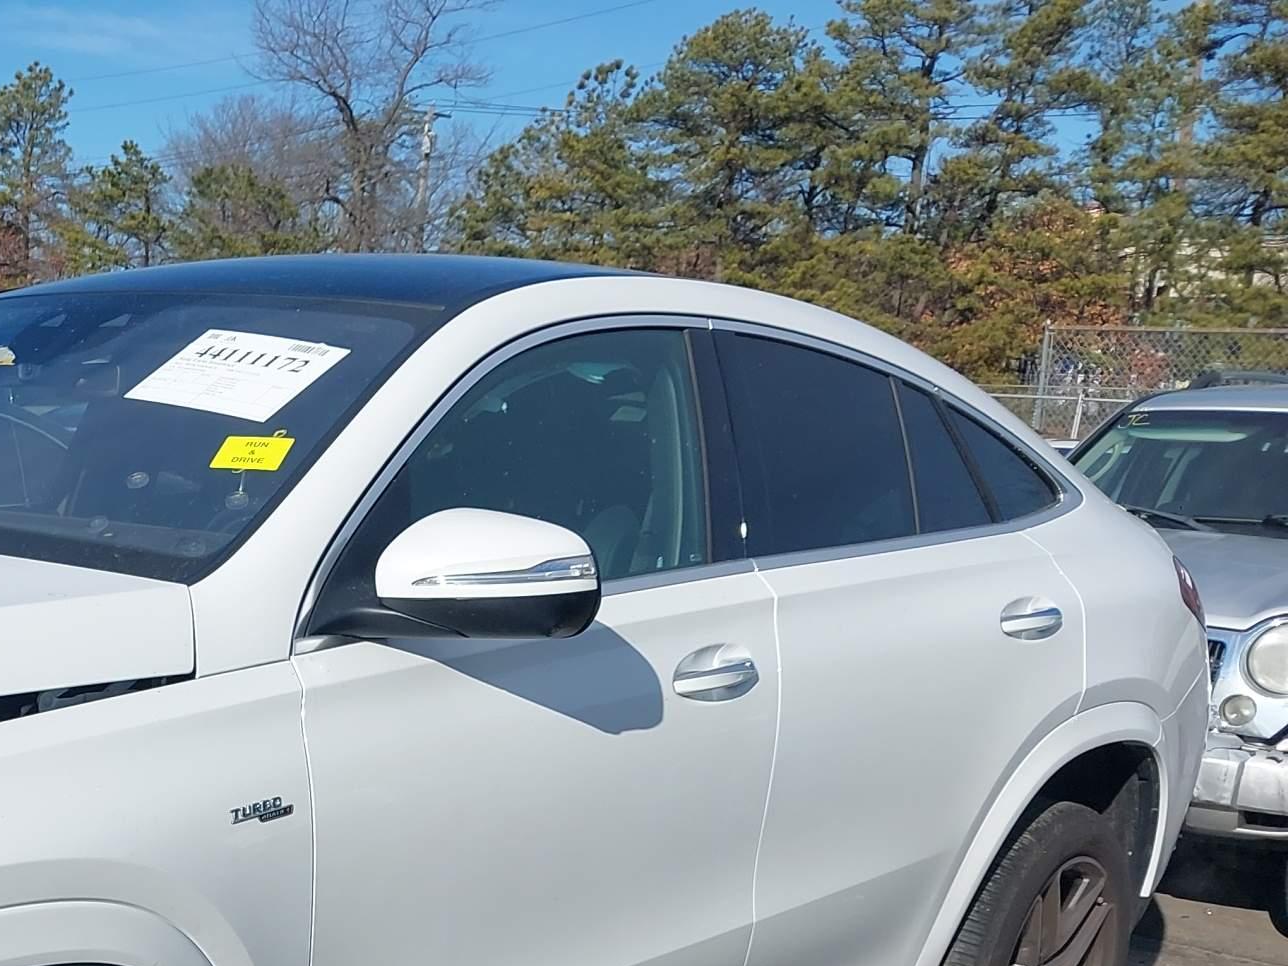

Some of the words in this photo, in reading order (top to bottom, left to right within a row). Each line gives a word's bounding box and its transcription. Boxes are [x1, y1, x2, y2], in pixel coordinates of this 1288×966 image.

[195, 345, 310, 373] 44111172
[231, 456, 265, 464] DRIVE
[230, 796, 282, 823] TURBO
